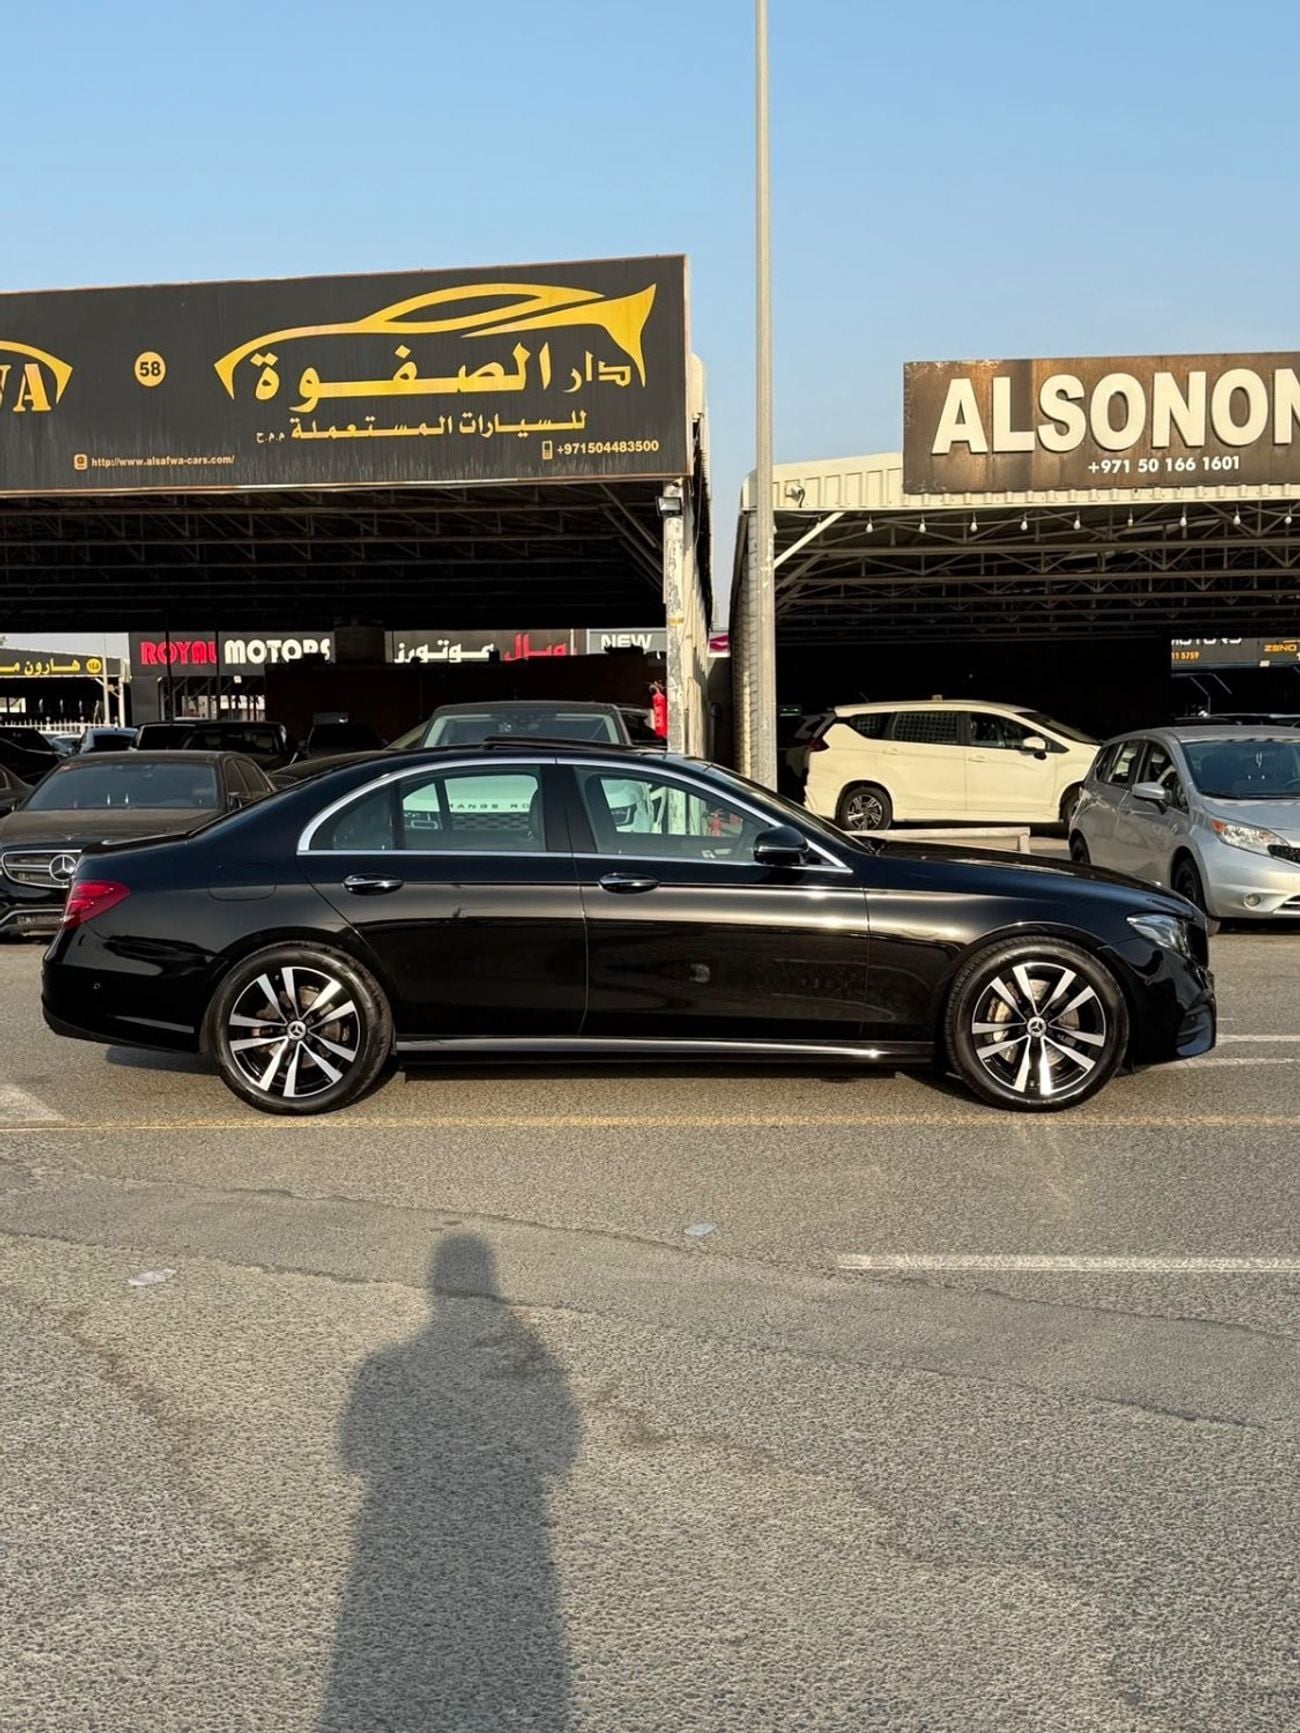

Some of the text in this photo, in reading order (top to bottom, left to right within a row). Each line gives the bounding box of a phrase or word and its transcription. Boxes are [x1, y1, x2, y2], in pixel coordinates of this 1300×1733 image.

[139, 361, 162, 377] 58
[250, 342, 632, 413] دار الصفوة
[289, 415, 453, 440] المستعملة
[459, 409, 588, 439] للسيارات
[557, 439, 660, 455] +971504483500
[91, 454, 235, 468] http://www.alsafwa-cars.com/
[1088, 456, 1240, 474] +971 50 166 1601
[601, 634, 653, 651] NEW
[139, 640, 217, 665] ROYAL
[23, 658, 81, 675] هارون
